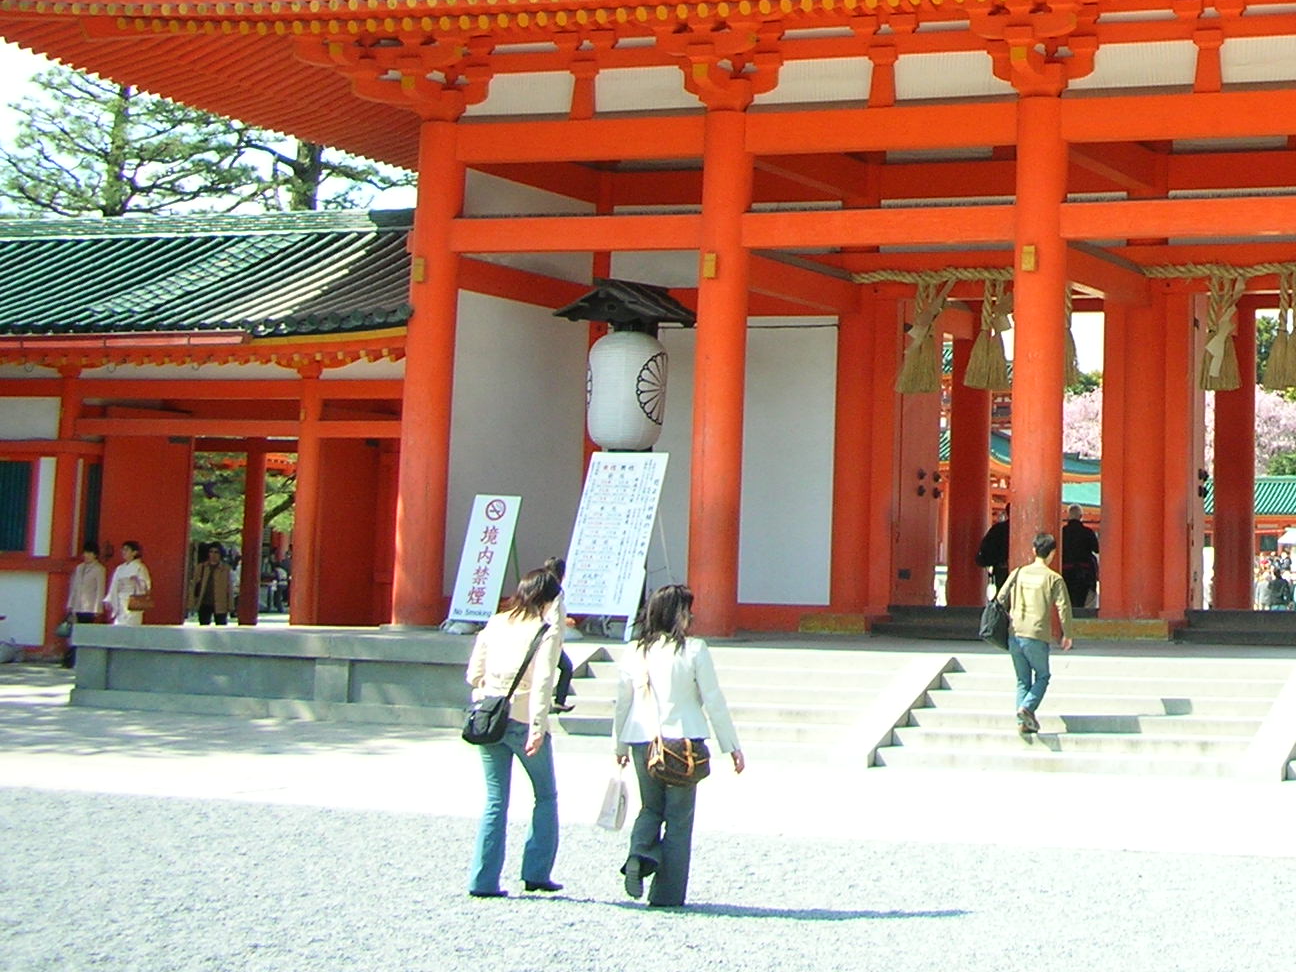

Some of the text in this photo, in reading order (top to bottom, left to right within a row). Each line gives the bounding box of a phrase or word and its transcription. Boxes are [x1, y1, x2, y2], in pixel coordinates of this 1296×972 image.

[466, 525, 499, 605] 境内禁煙
[465, 609, 492, 618] Smoking
